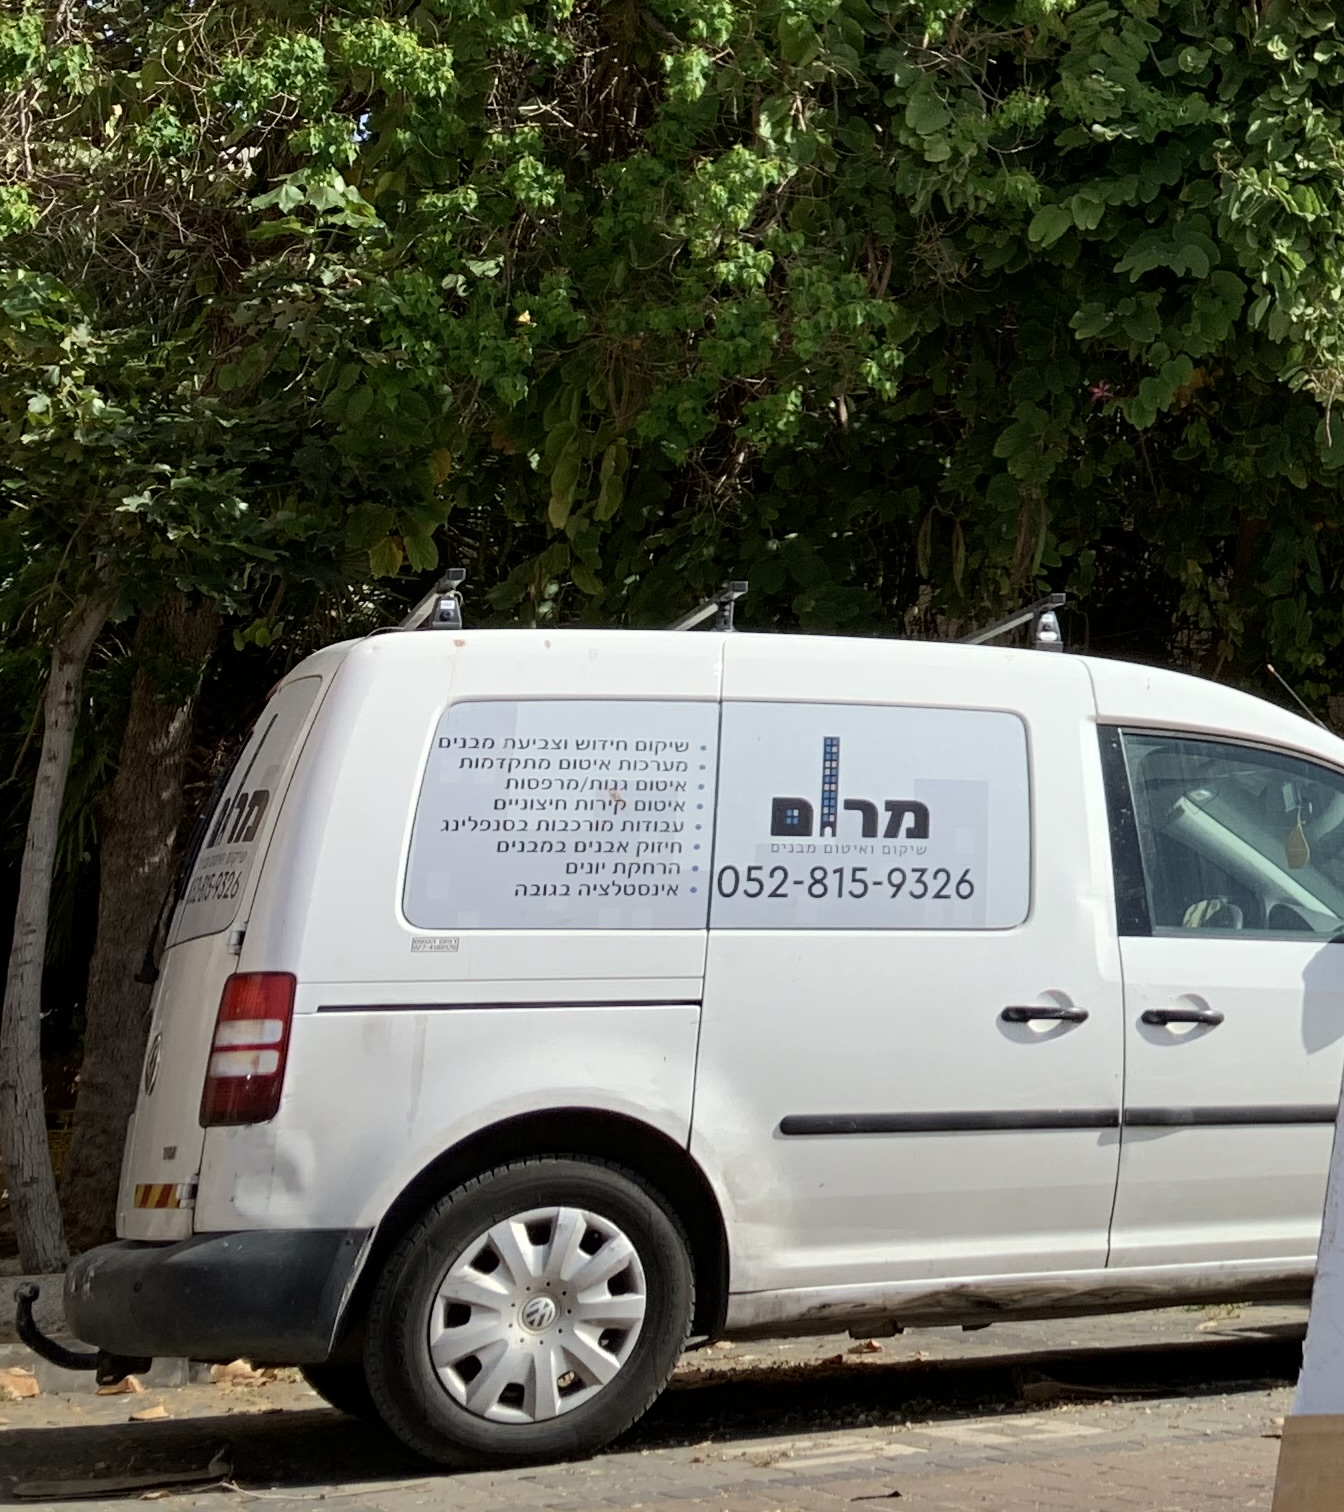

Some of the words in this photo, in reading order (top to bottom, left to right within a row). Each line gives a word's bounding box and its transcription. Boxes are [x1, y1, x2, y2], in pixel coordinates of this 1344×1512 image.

[437, 736, 496, 750] מבנים
[501, 737, 568, 751] וצביעת
[575, 738, 628, 751] חידוש
[634, 738, 690, 756] שיקום
[458, 756, 551, 773] מתקדמות
[558, 757, 611, 771] איטום
[617, 758, 689, 773] מערכות
[504, 776, 629, 793] גגות/מרפסות
[635, 778, 688, 793] איטום
[770, 735, 930, 839] מרום
[493, 797, 568, 811] חיצוניים
[574, 798, 627, 815] קירות
[634, 799, 686, 813] איטום
[440, 815, 529, 833] בסנפלינג
[535, 819, 614, 833] מורכבות
[620, 819, 685, 833] עבודות
[496, 840, 567, 854] במבנים
[573, 841, 630, 854] אבנים
[635, 841, 683, 858] חיזוק
[770, 842, 817, 854] מבנים
[823, 843, 875, 855] ואיטום
[881, 843, 928, 858] שיקום
[565, 861, 606, 876] יונים
[611, 861, 681, 879] הרחקת
[577, 879, 679, 898] אינסטלציה
[716, 864, 976, 900] 052-815-9326
[513, 882, 571, 898] בגובה
